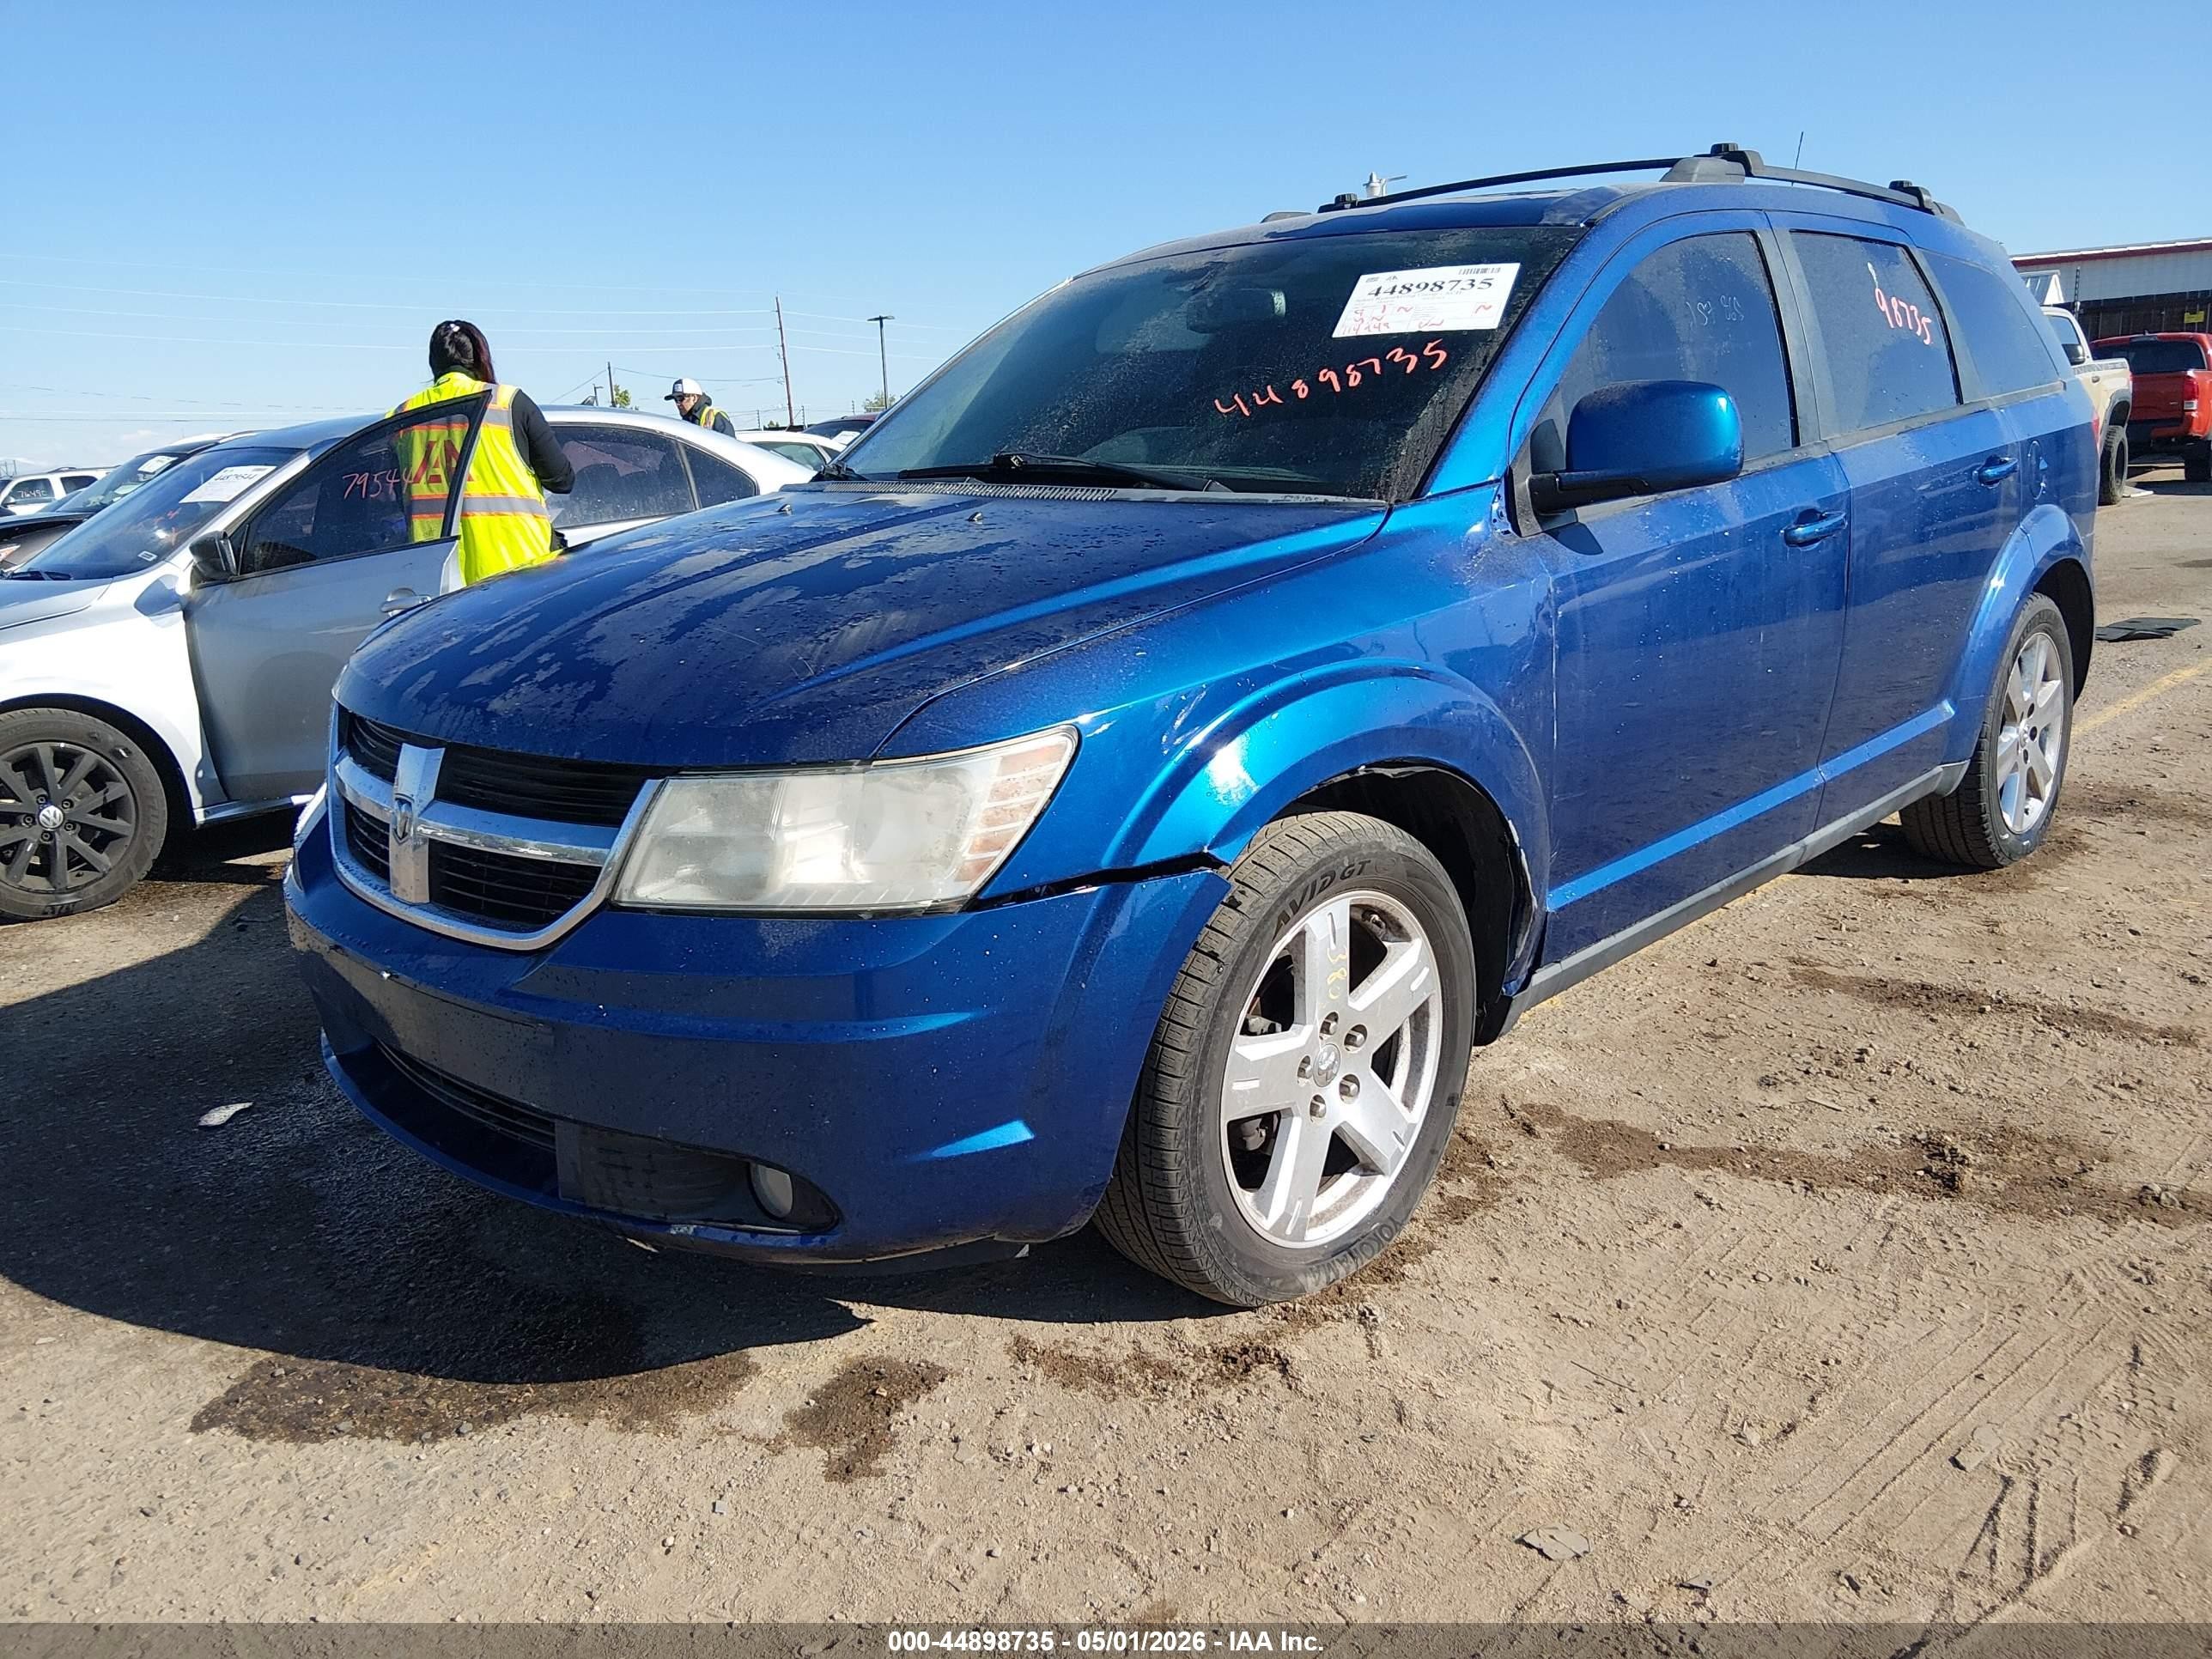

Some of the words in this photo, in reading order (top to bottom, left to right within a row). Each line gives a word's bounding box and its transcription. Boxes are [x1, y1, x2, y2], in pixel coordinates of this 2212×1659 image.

[1368, 278, 1494, 297] 44898735
[1875, 288, 1932, 345] 98735
[1214, 339, 1448, 416] 44898735
[342, 468, 414, 499] 79544
[1272, 869, 1336, 941] AVID
[1340, 860, 1371, 880] GT
